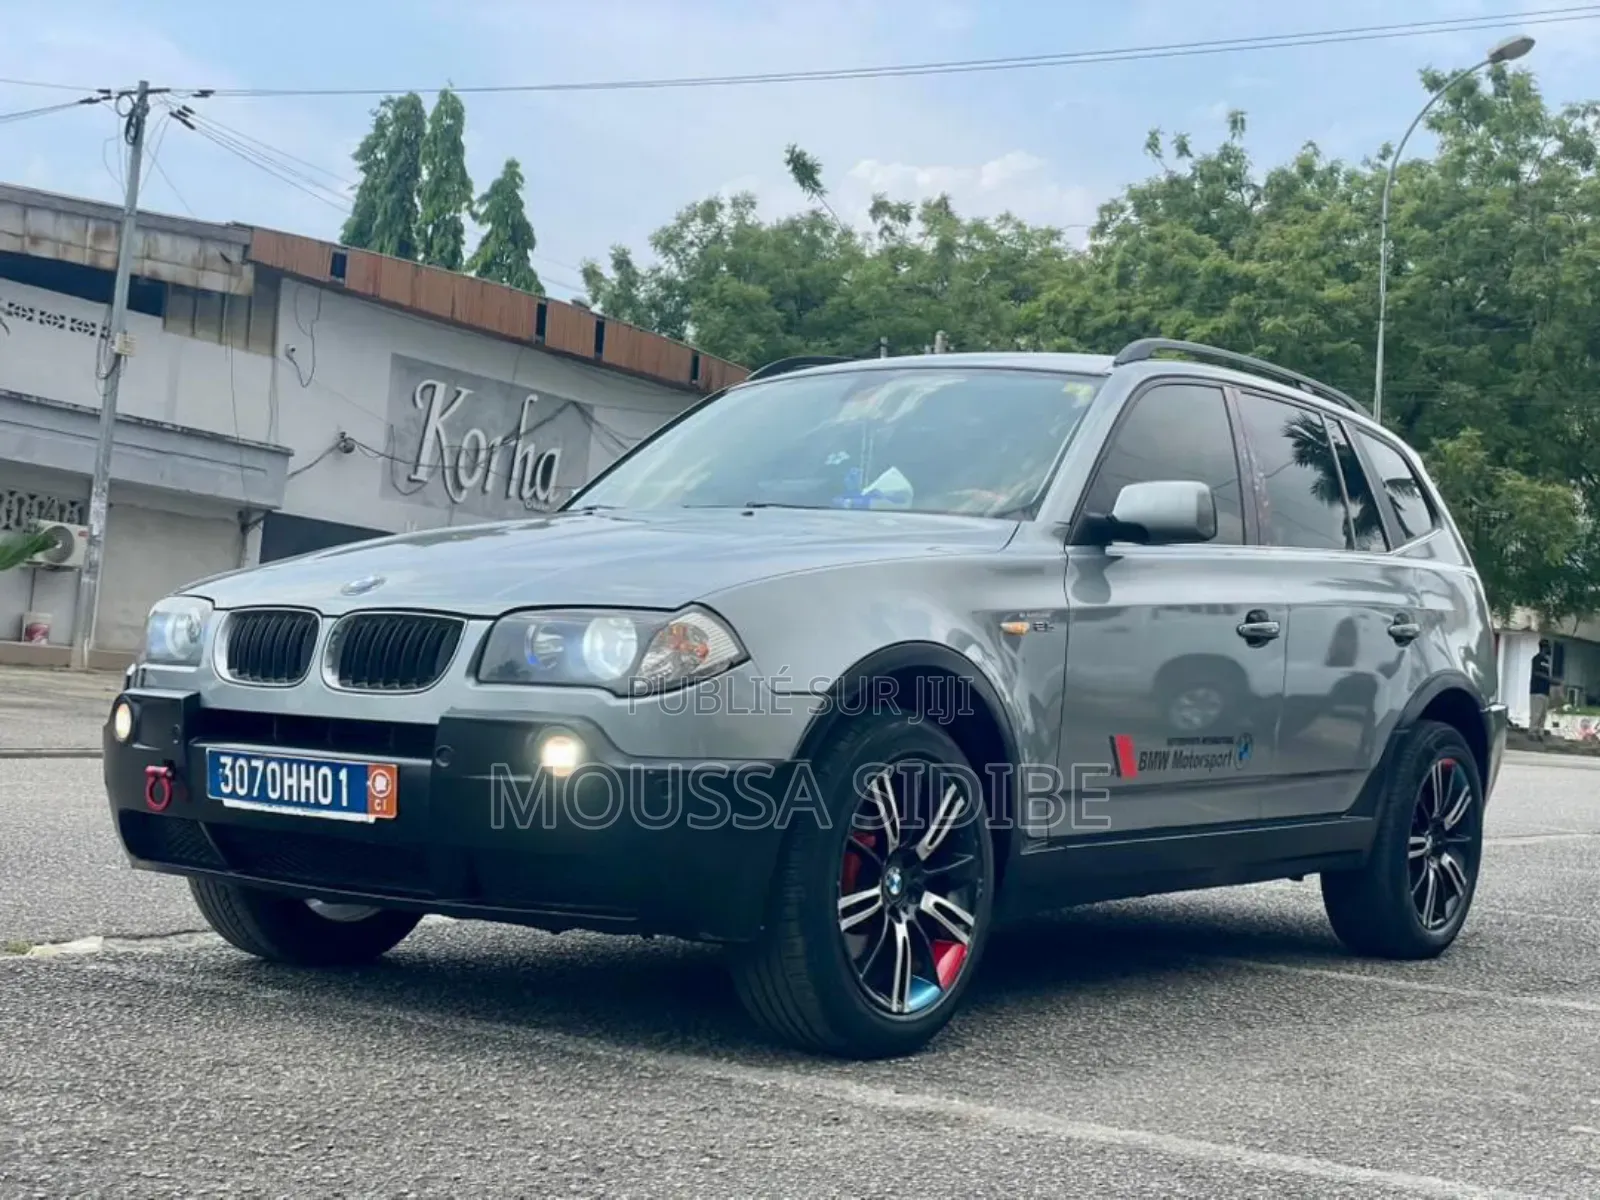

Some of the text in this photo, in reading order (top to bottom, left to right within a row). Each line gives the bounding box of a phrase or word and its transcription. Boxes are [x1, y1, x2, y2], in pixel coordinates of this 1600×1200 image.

[413, 379, 563, 504] Korha
[219, 756, 348, 807] 3070HH01
[1138, 748, 1233, 772] BMW Motorsport
